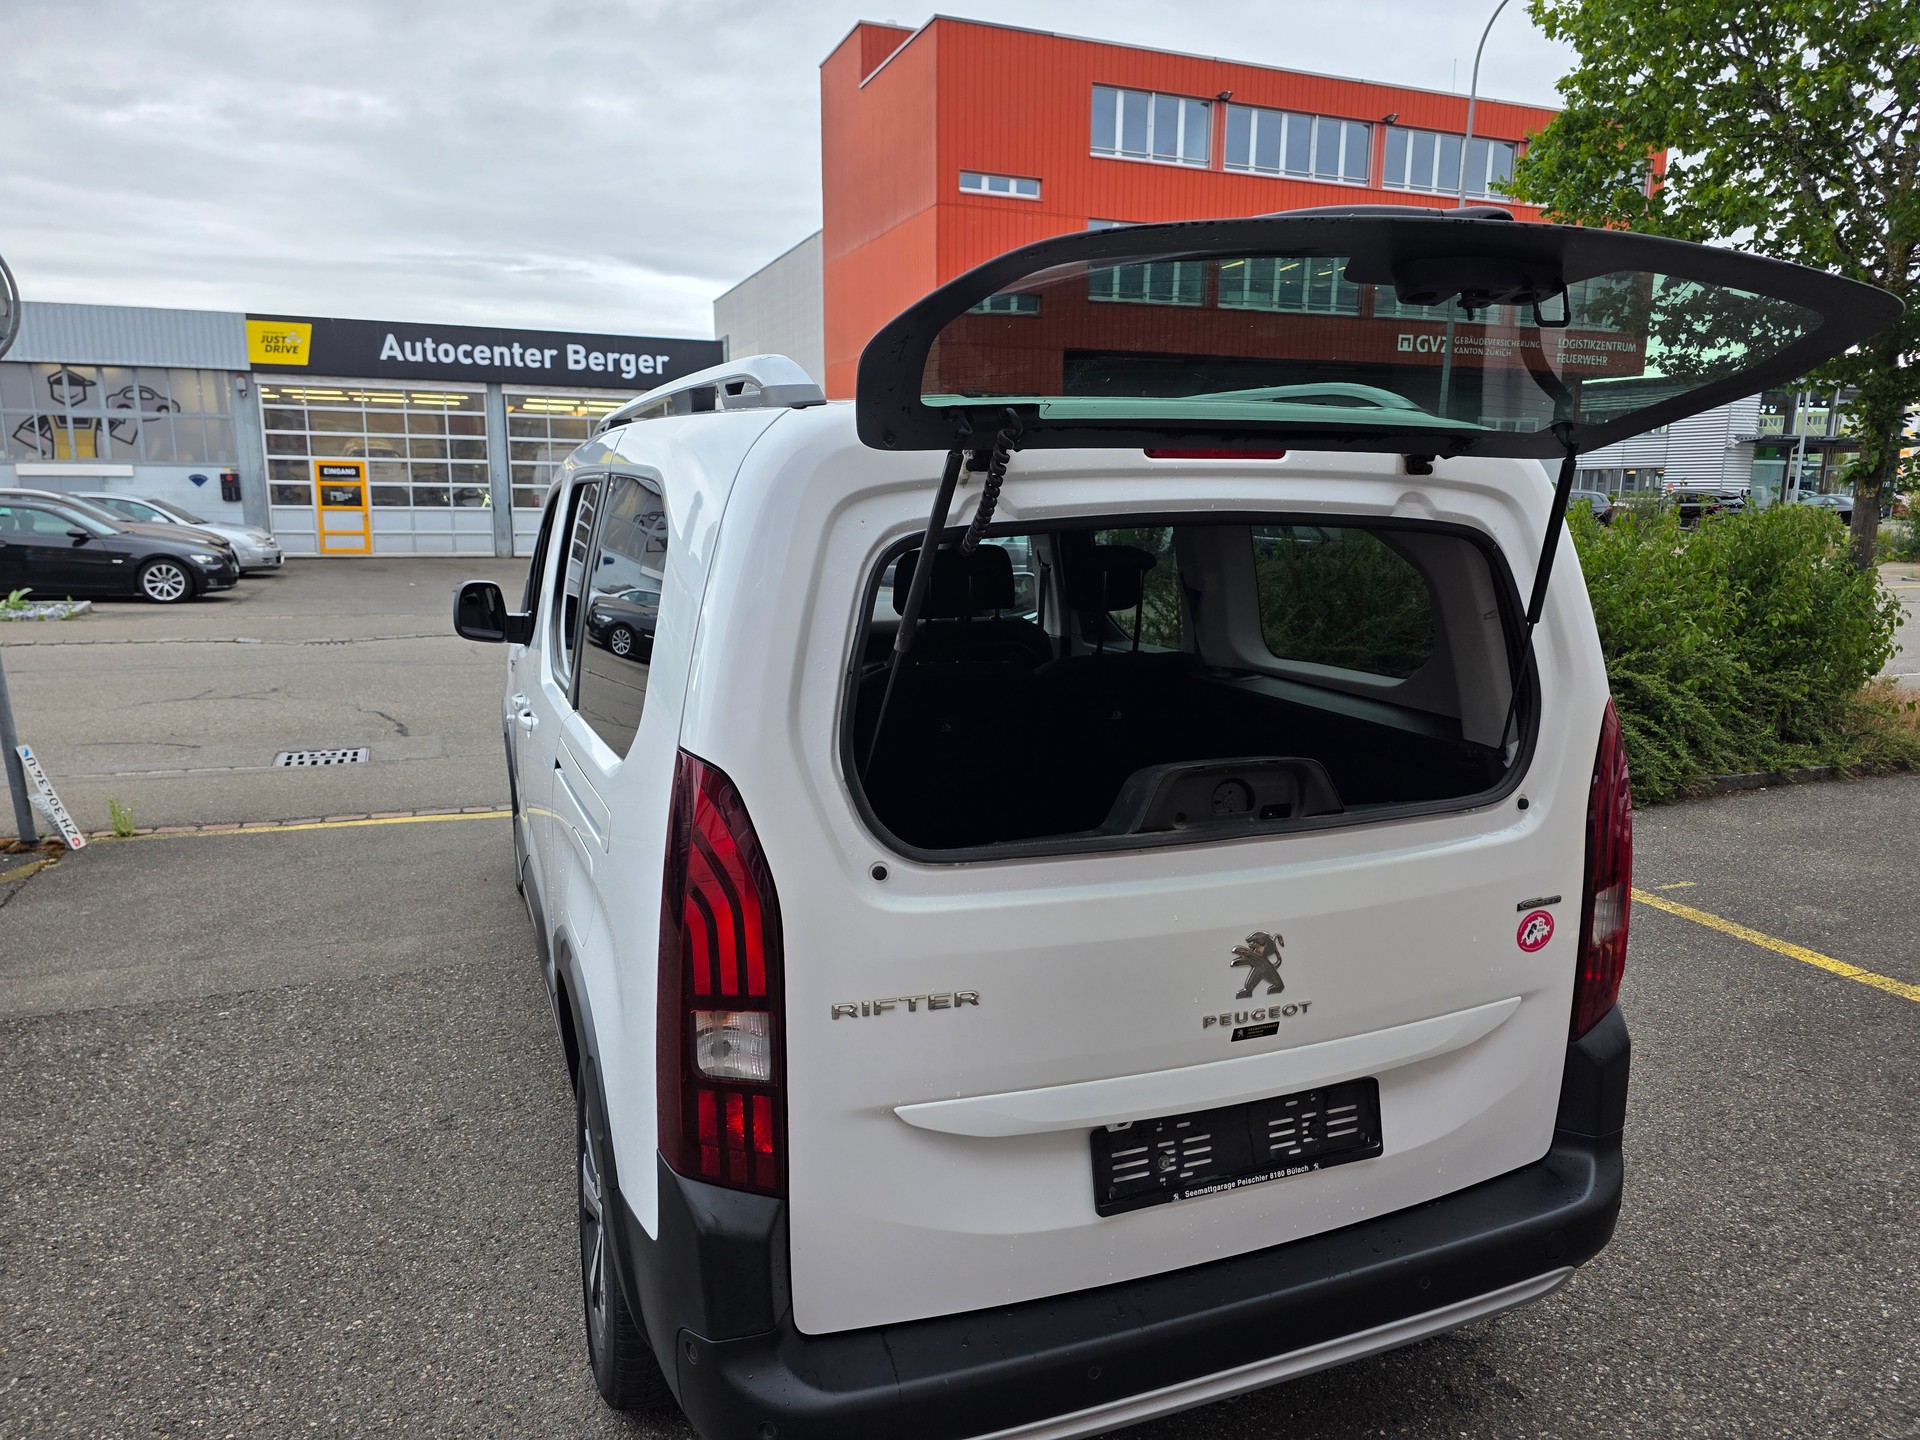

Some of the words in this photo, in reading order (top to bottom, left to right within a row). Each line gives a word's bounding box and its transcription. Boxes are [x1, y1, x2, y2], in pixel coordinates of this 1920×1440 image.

[260, 335, 288, 344] JUST
[1454, 335, 1541, 349] GEBÄUDEVERSICHERUNG
[1557, 338, 1637, 352] LOGISTIKZENTRUM
[264, 344, 300, 354] DRIVE
[1454, 347, 1484, 355] KANTON
[1485, 347, 1512, 357] ZÜRICH
[379, 333, 558, 369] Autocenter
[566, 343, 670, 380] Berger
[1556, 353, 1609, 366] FEUERWEHR
[831, 989, 980, 1021] RIFTER
[1202, 1000, 1313, 1029] PEUGEOT
[1184, 1182, 1236, 1198] Seemattgarage
[1269, 1169, 1286, 1180] 8180
[1286, 1165, 1309, 1176] Bülach
